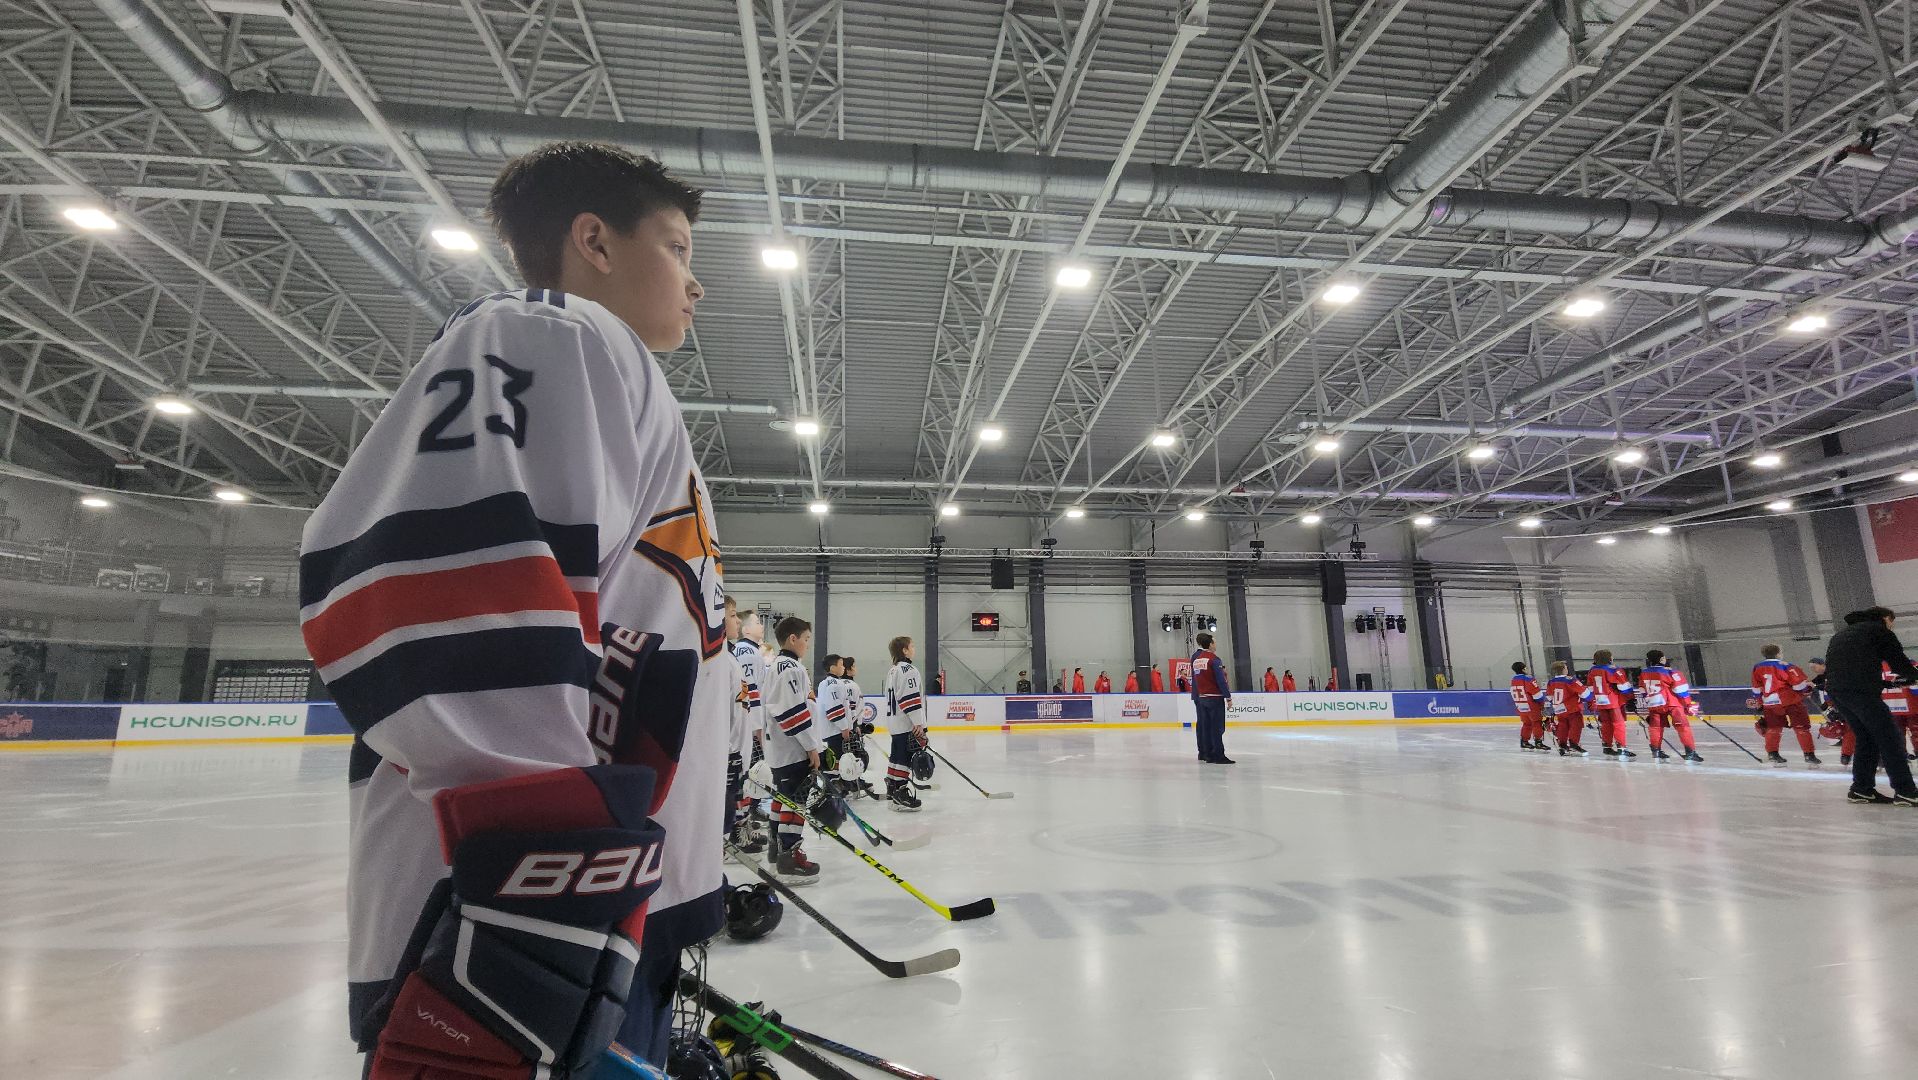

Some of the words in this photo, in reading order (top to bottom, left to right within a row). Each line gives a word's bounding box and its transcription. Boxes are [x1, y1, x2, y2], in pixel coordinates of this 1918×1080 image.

[418, 353, 534, 455] 23
[907, 677, 917, 688] 91
[1293, 701, 1389, 712] HCUNISON.RU
[130, 714, 298, 729] HCUNISON.RU
[859, 852, 905, 884] CCM
[416, 1000, 471, 1048] VAPOR
